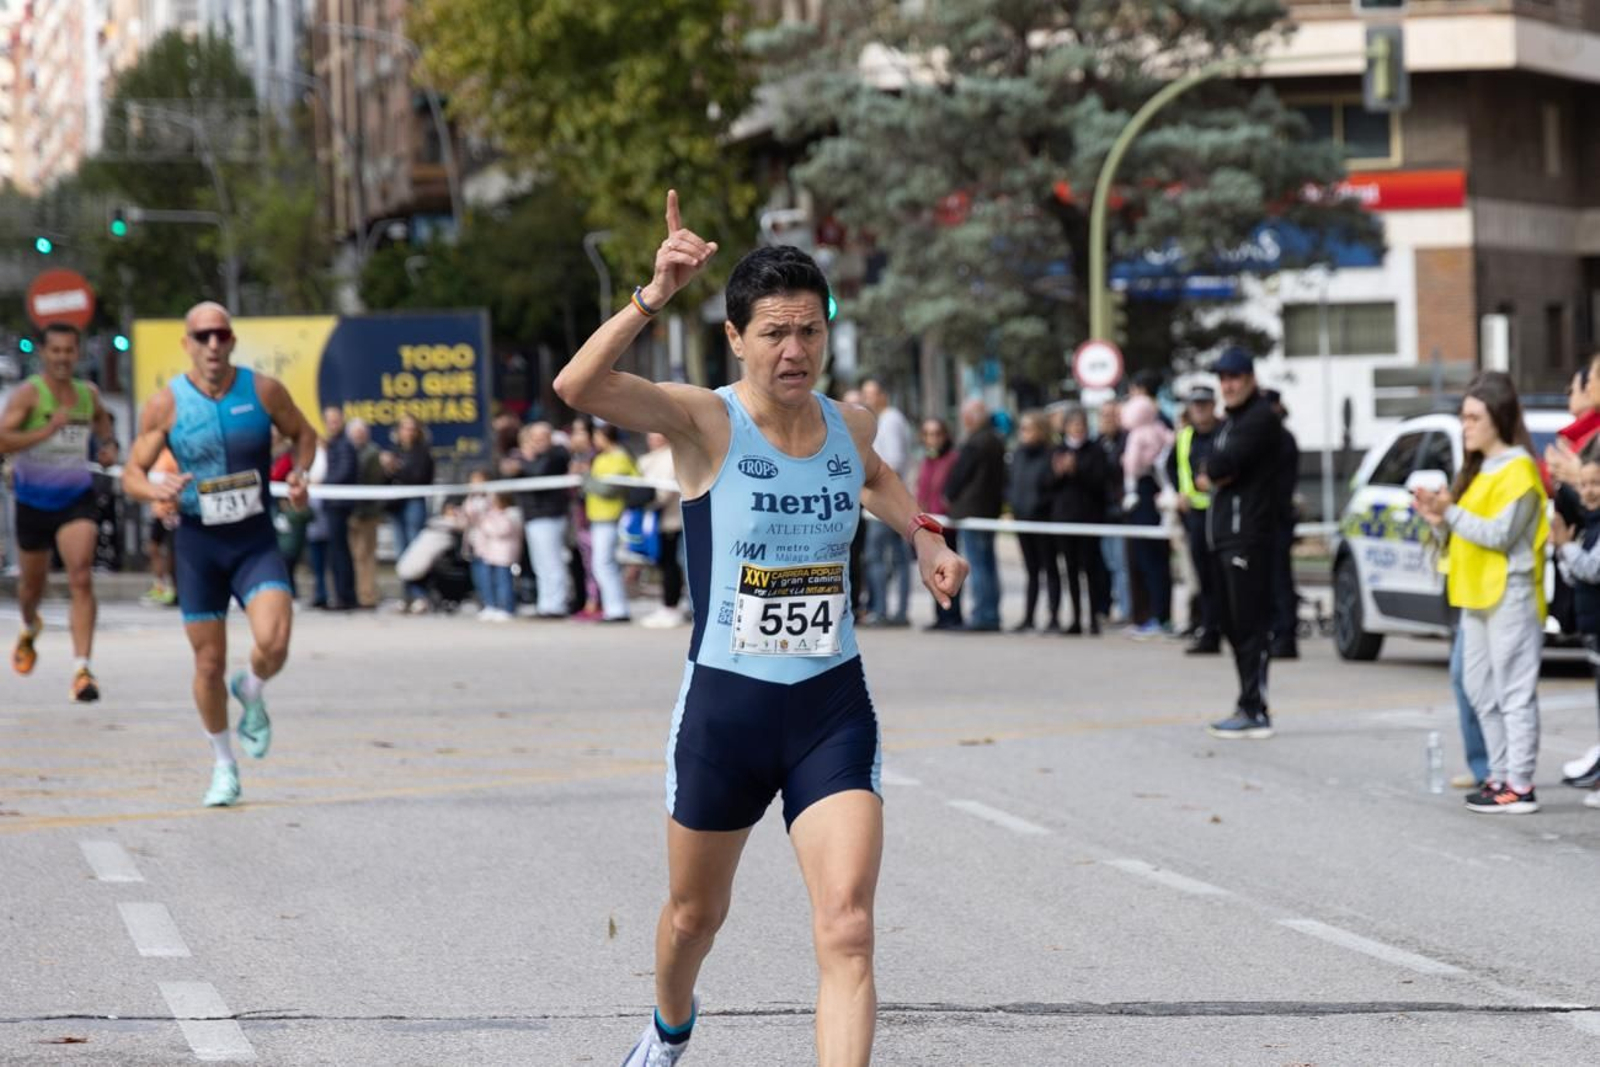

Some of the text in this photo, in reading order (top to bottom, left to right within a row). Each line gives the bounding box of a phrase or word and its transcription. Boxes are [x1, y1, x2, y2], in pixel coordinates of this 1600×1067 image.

[399, 344, 476, 370] TODO
[381, 371, 476, 398] LO QUE
[343, 398, 478, 425] NECESITAS
[740, 459, 778, 477] TROPS
[212, 493, 247, 512] 731
[751, 486, 853, 520] nerja
[766, 522, 843, 535] ATLETISMO
[776, 543, 810, 552] metro
[744, 568, 770, 588] XXV
[771, 569, 810, 580] CARRERA
[781, 577, 803, 587] gran
[759, 600, 832, 636] 554
